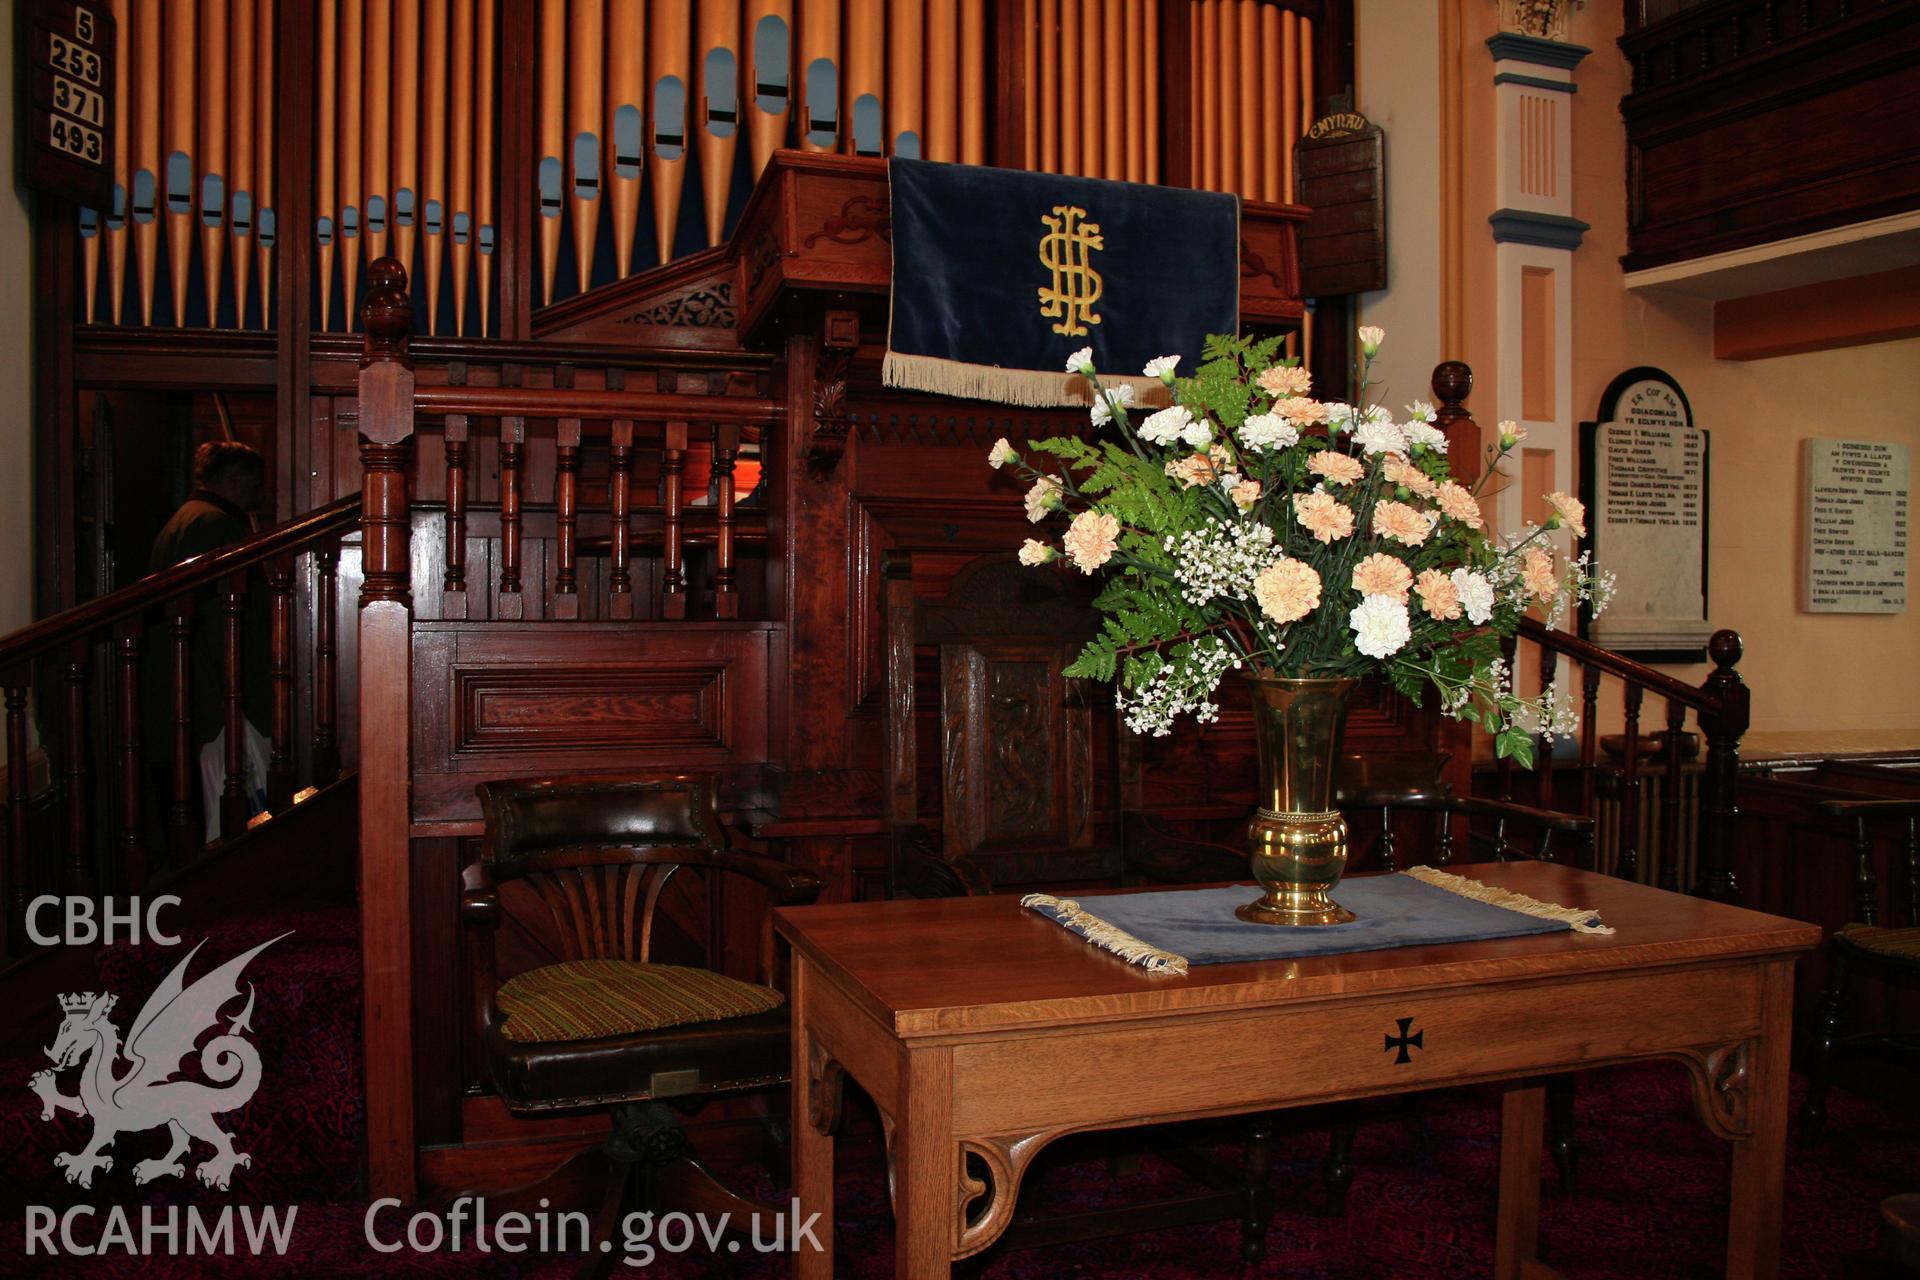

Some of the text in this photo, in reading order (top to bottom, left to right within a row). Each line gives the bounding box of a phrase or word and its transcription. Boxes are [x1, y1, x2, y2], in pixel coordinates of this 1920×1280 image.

[78, 13, 92, 41] 5
[52, 39, 99, 83] 253
[56, 80, 99, 123] 371
[52, 119, 100, 161] 493
[1310, 113, 1365, 139] EMYNAU
